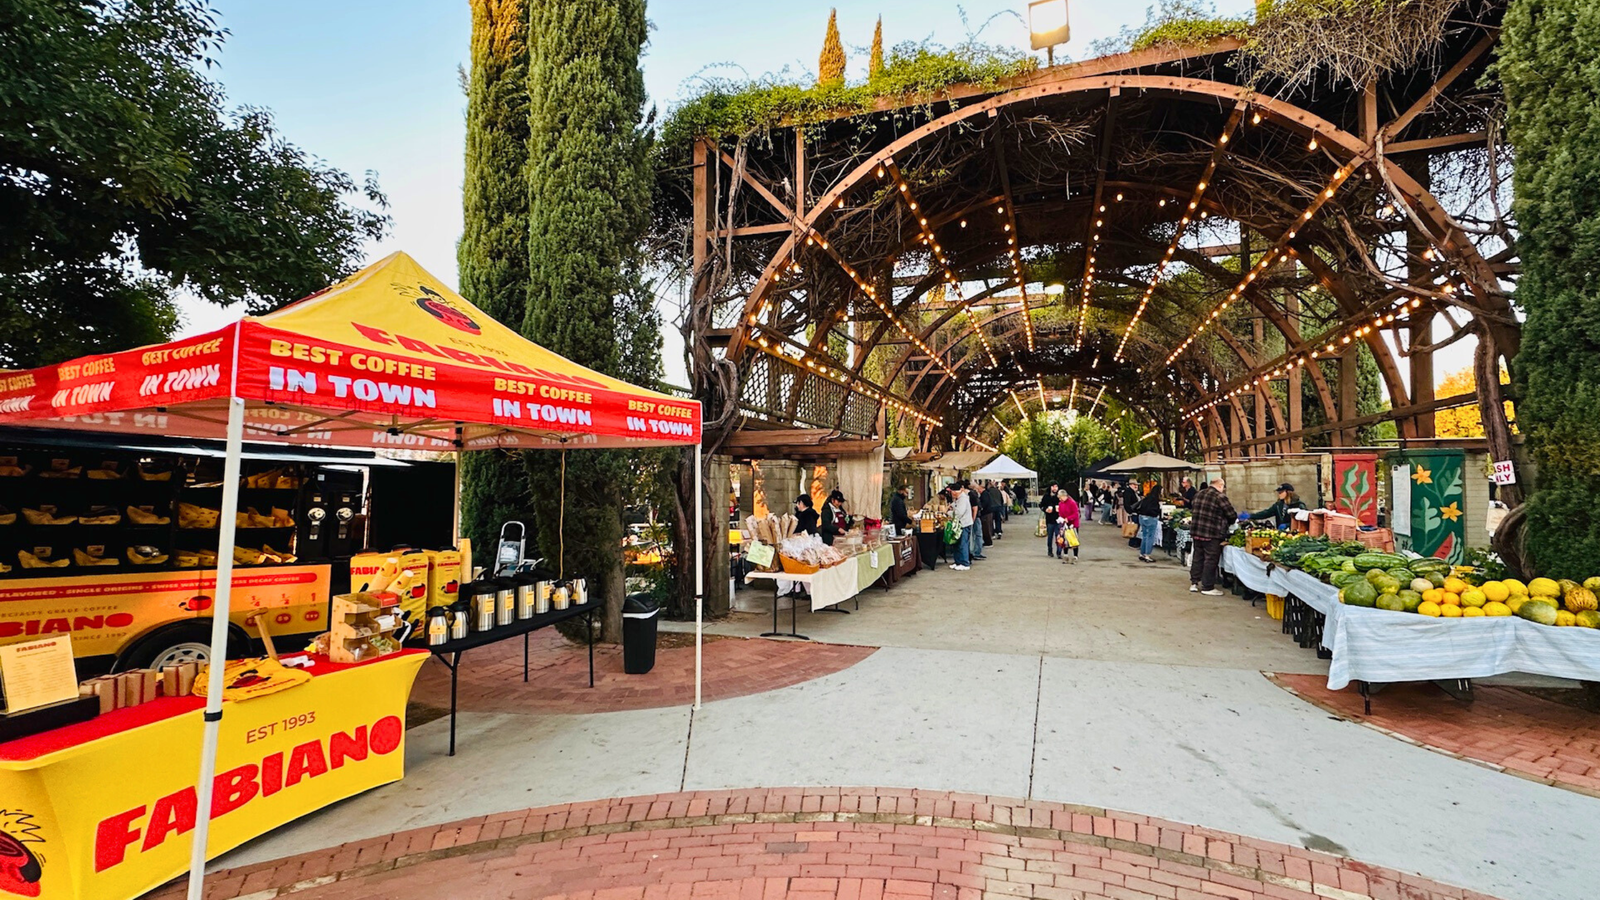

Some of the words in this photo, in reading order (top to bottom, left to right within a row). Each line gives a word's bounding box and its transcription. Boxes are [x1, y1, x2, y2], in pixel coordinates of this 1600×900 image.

[142, 350, 172, 367] BEST
[171, 337, 224, 359] COFFEE
[269, 339, 343, 366] BEST
[350, 353, 436, 381] COFFEE
[351, 321, 610, 389] FABIANO
[8, 373, 37, 392] COFFEE
[57, 365, 82, 382] BEST
[82, 357, 116, 377] COFFEE
[139, 373, 164, 397] IN
[163, 363, 221, 393] TOWN
[51, 388, 71, 408] IN
[70, 381, 115, 406] TOWN
[269, 366, 317, 394] IN
[328, 375, 437, 408] TOWN
[493, 377, 536, 396] BEST
[539, 382, 593, 405] COFFEE
[492, 398, 521, 419] IN
[526, 402, 593, 427] TOWN
[628, 400, 655, 413] BEST
[657, 403, 693, 419] COFFEE
[625, 416, 646, 432] IN
[649, 419, 693, 437] TOWN
[1496, 464, 1511, 473] SH
[66, 586, 102, 595] SINGLE
[103, 585, 144, 593] ORIGINS
[16, 641, 57, 653] FABIANO
[246, 722, 279, 744] EST
[282, 711, 316, 731] 1993
[94, 714, 402, 874] FABIANO
